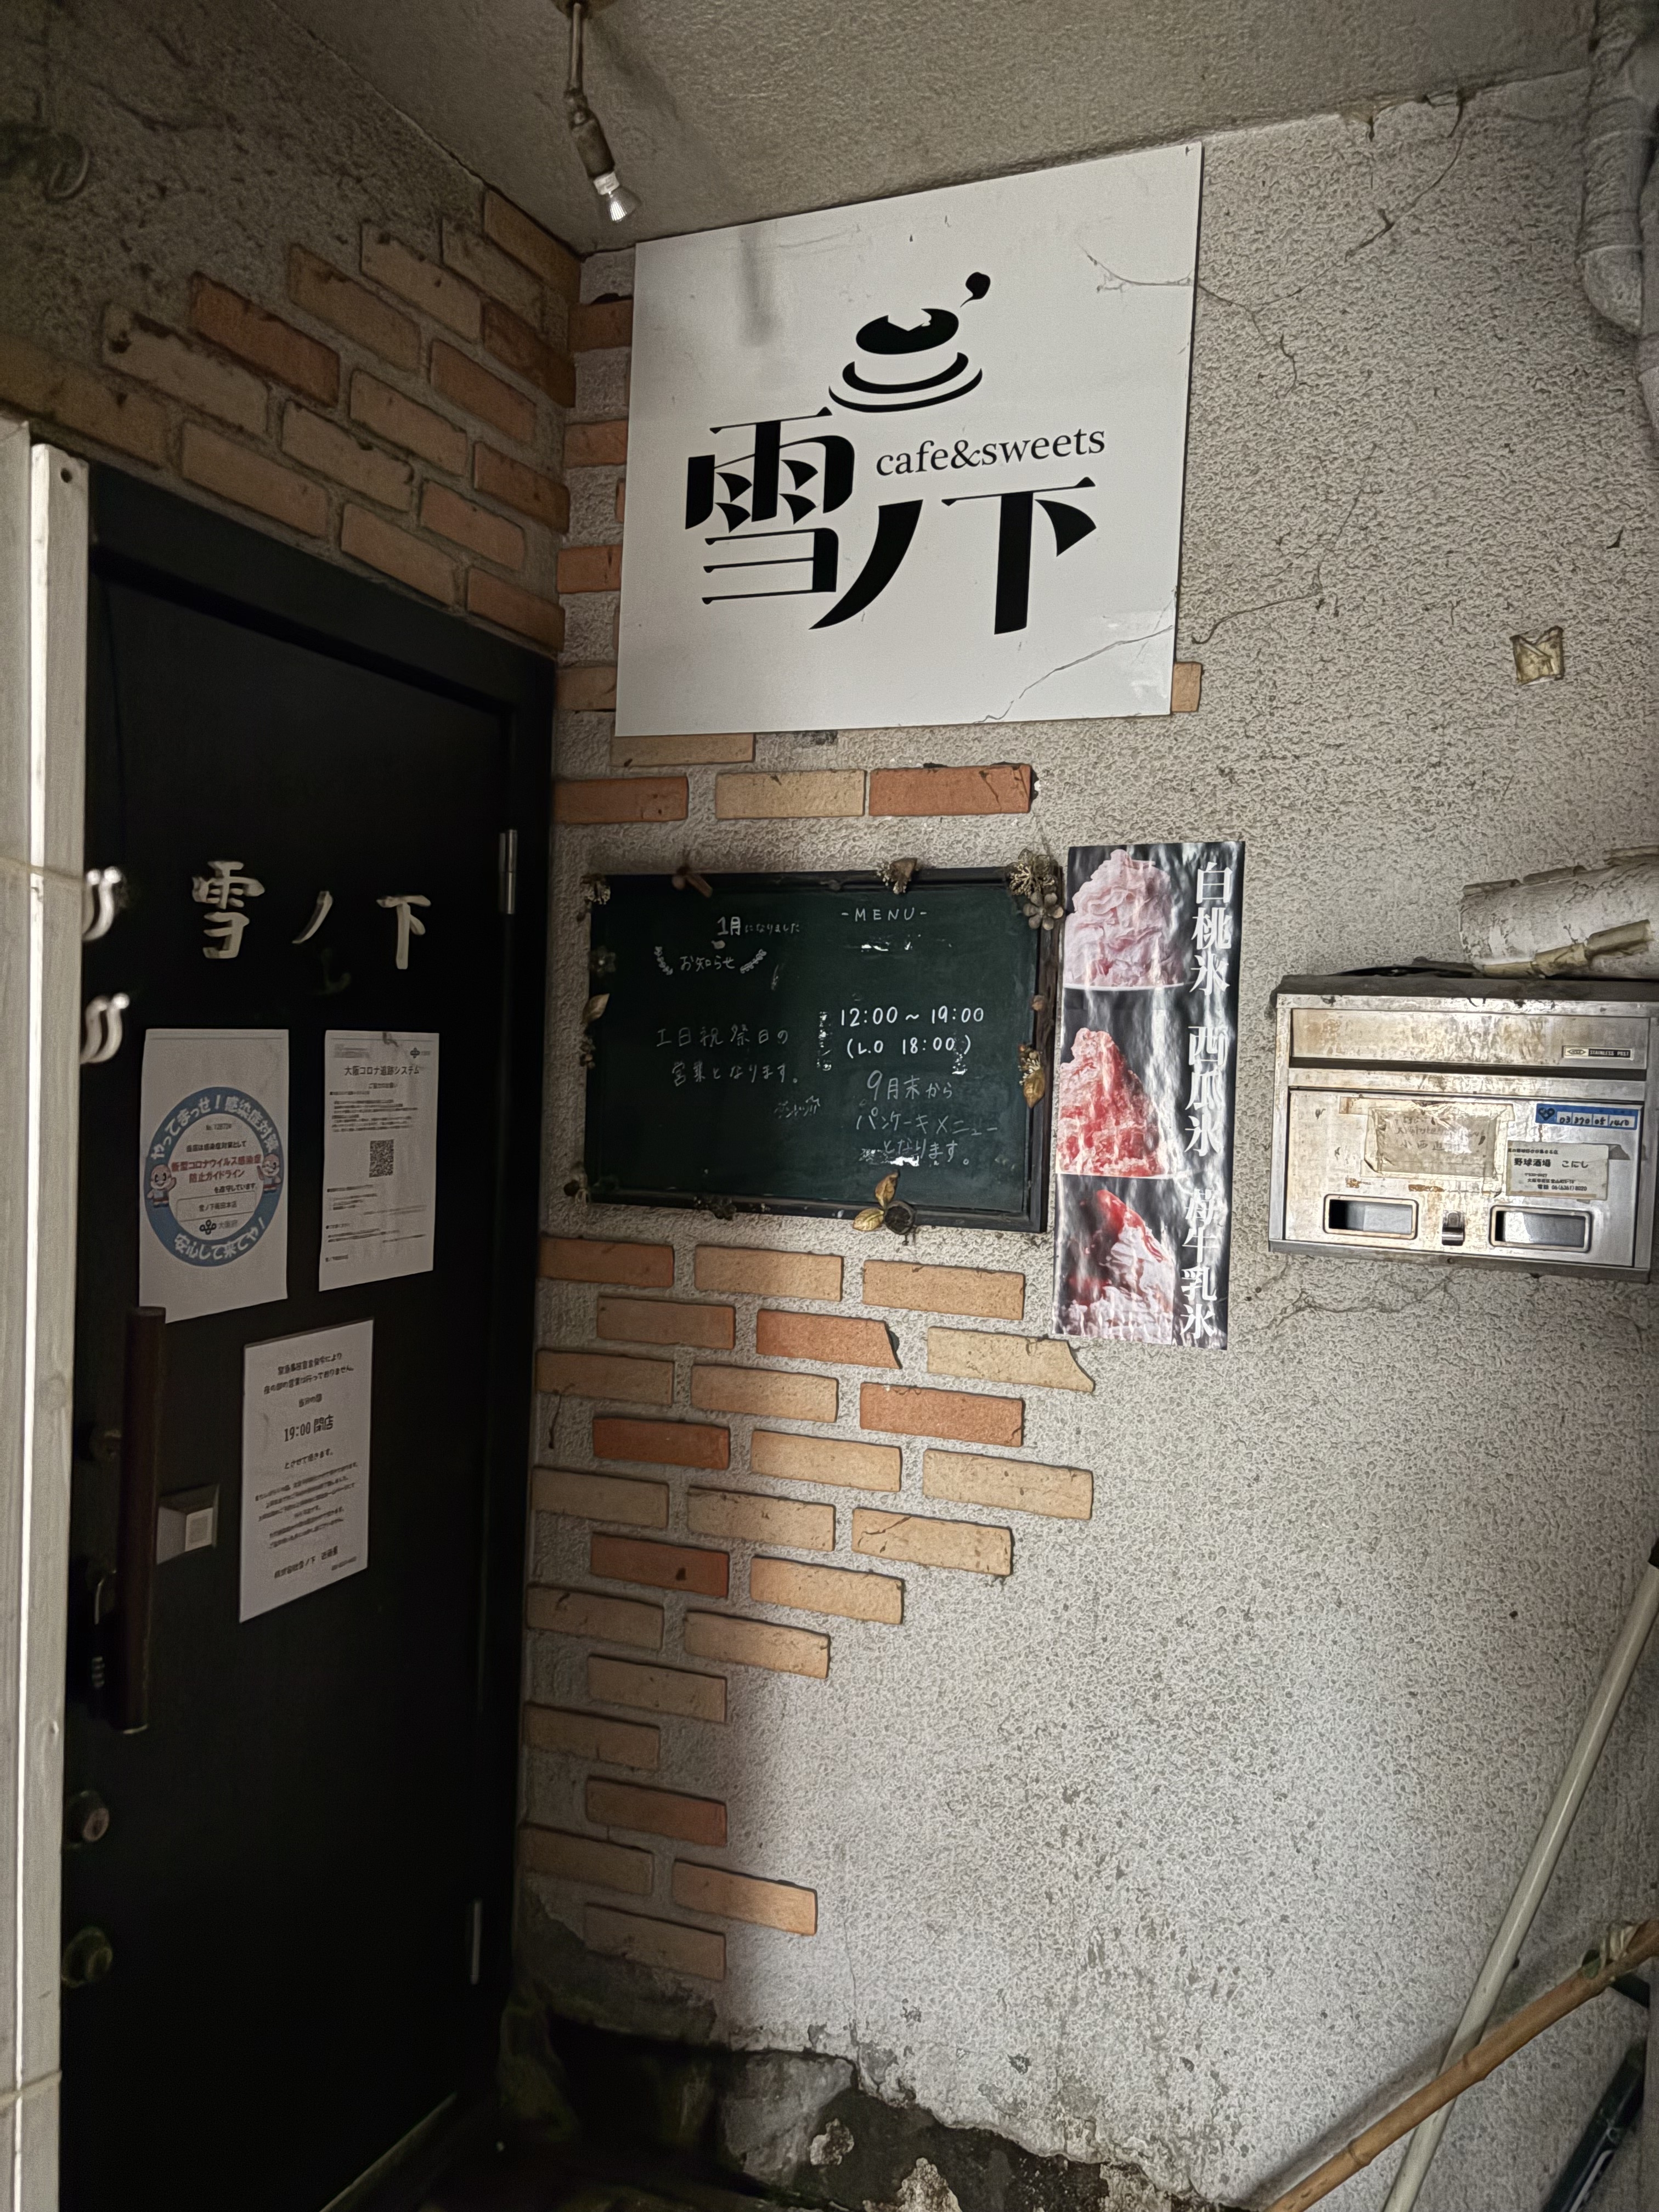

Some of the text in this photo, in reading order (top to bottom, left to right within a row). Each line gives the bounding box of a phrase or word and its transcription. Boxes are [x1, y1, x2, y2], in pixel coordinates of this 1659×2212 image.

[875, 428, 1106, 476] cafe&sweets
[685, 406, 1097, 635] 雪ノ下
[192, 860, 431, 970] 雪ノ下
[1189, 861, 1233, 996] 白桃氷
[680, 955, 736, 972] お知らせ
[343, 1065, 420, 1076] 大阪コロナ追跡システム
[866, 1070, 953, 1102] 9月末から
[1184, 1026, 1227, 1156] 西瓜氷
[171, 1154, 262, 1173] 新型コロナウイルス感染症
[883, 1138, 969, 1166] となります。
[1514, 1158, 1589, 1169] 野球酒場 こにし
[189, 1169, 245, 1184] 防止ガイドライン
[284, 1414, 334, 1442] 19:00 閉店
